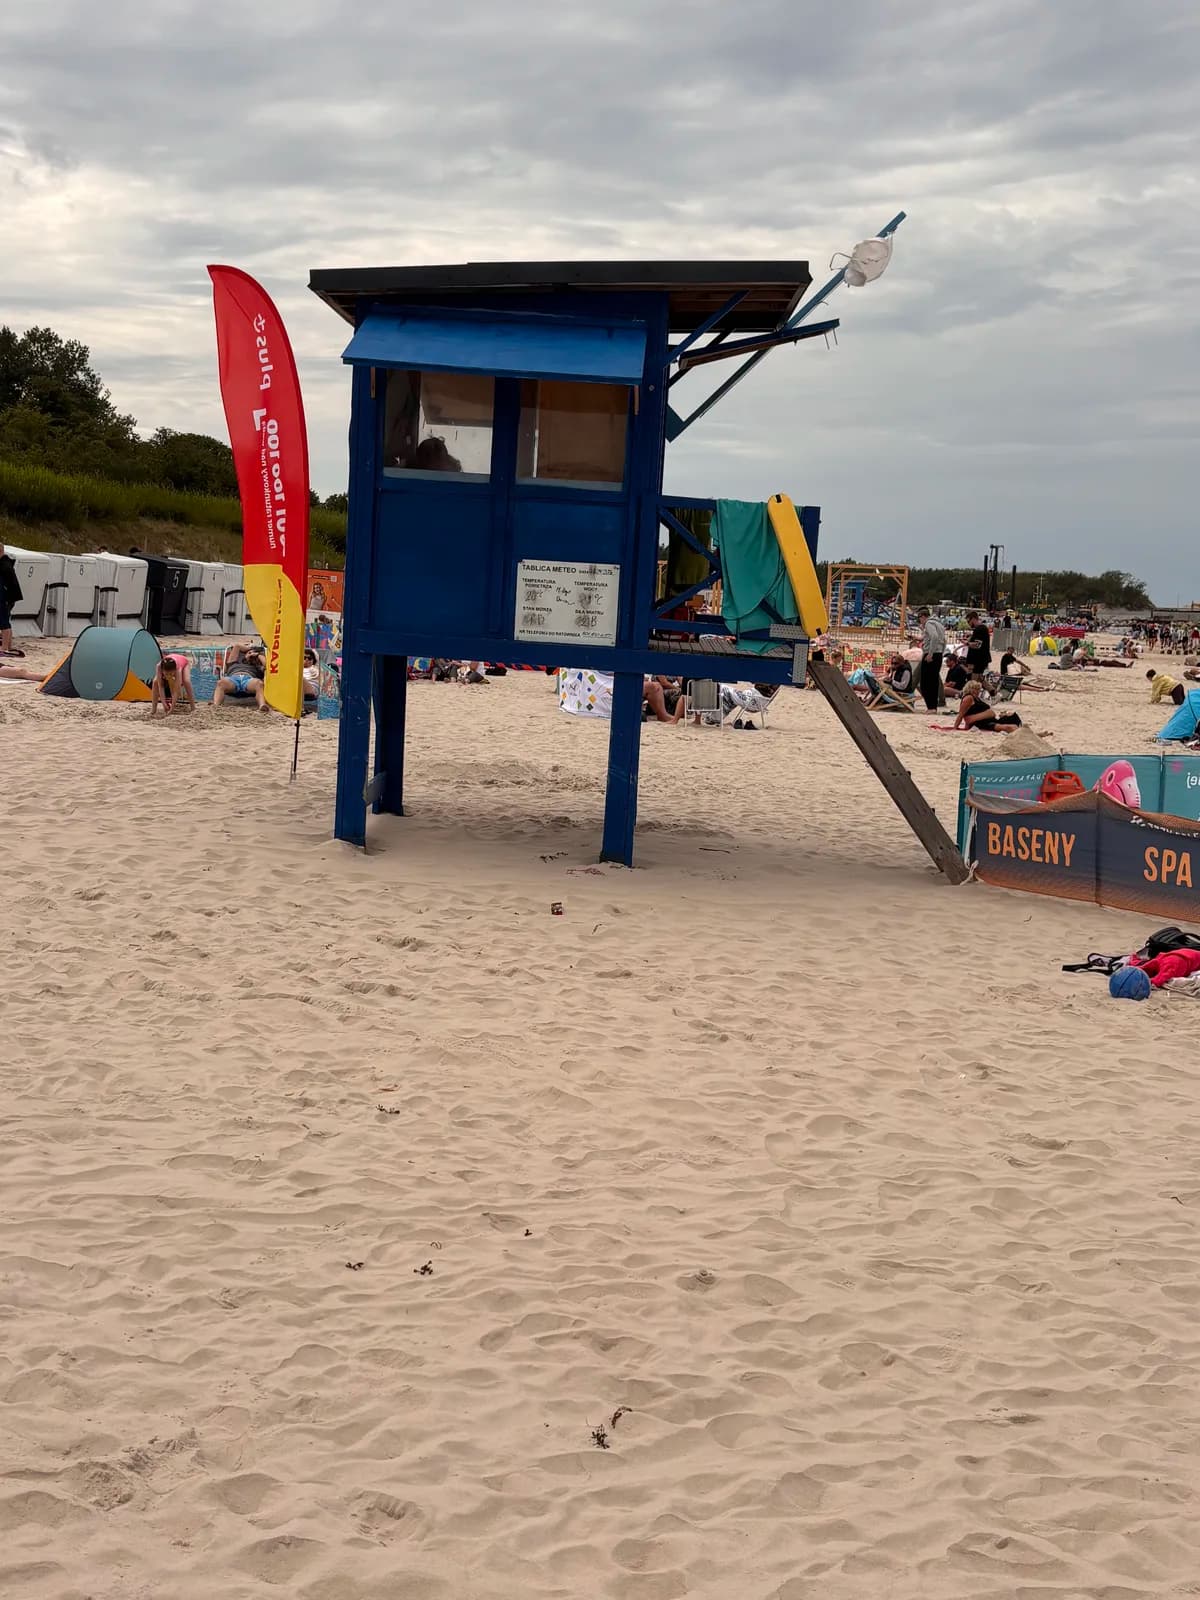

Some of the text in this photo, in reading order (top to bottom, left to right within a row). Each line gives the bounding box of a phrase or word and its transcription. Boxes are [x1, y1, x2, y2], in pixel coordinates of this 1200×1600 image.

[172, 570, 180, 588] 5
[522, 564, 551, 573] TABLICA
[552, 566, 577, 574] METEO
[987, 822, 1076, 867] BASENY
[1143, 846, 1193, 888] SPA
